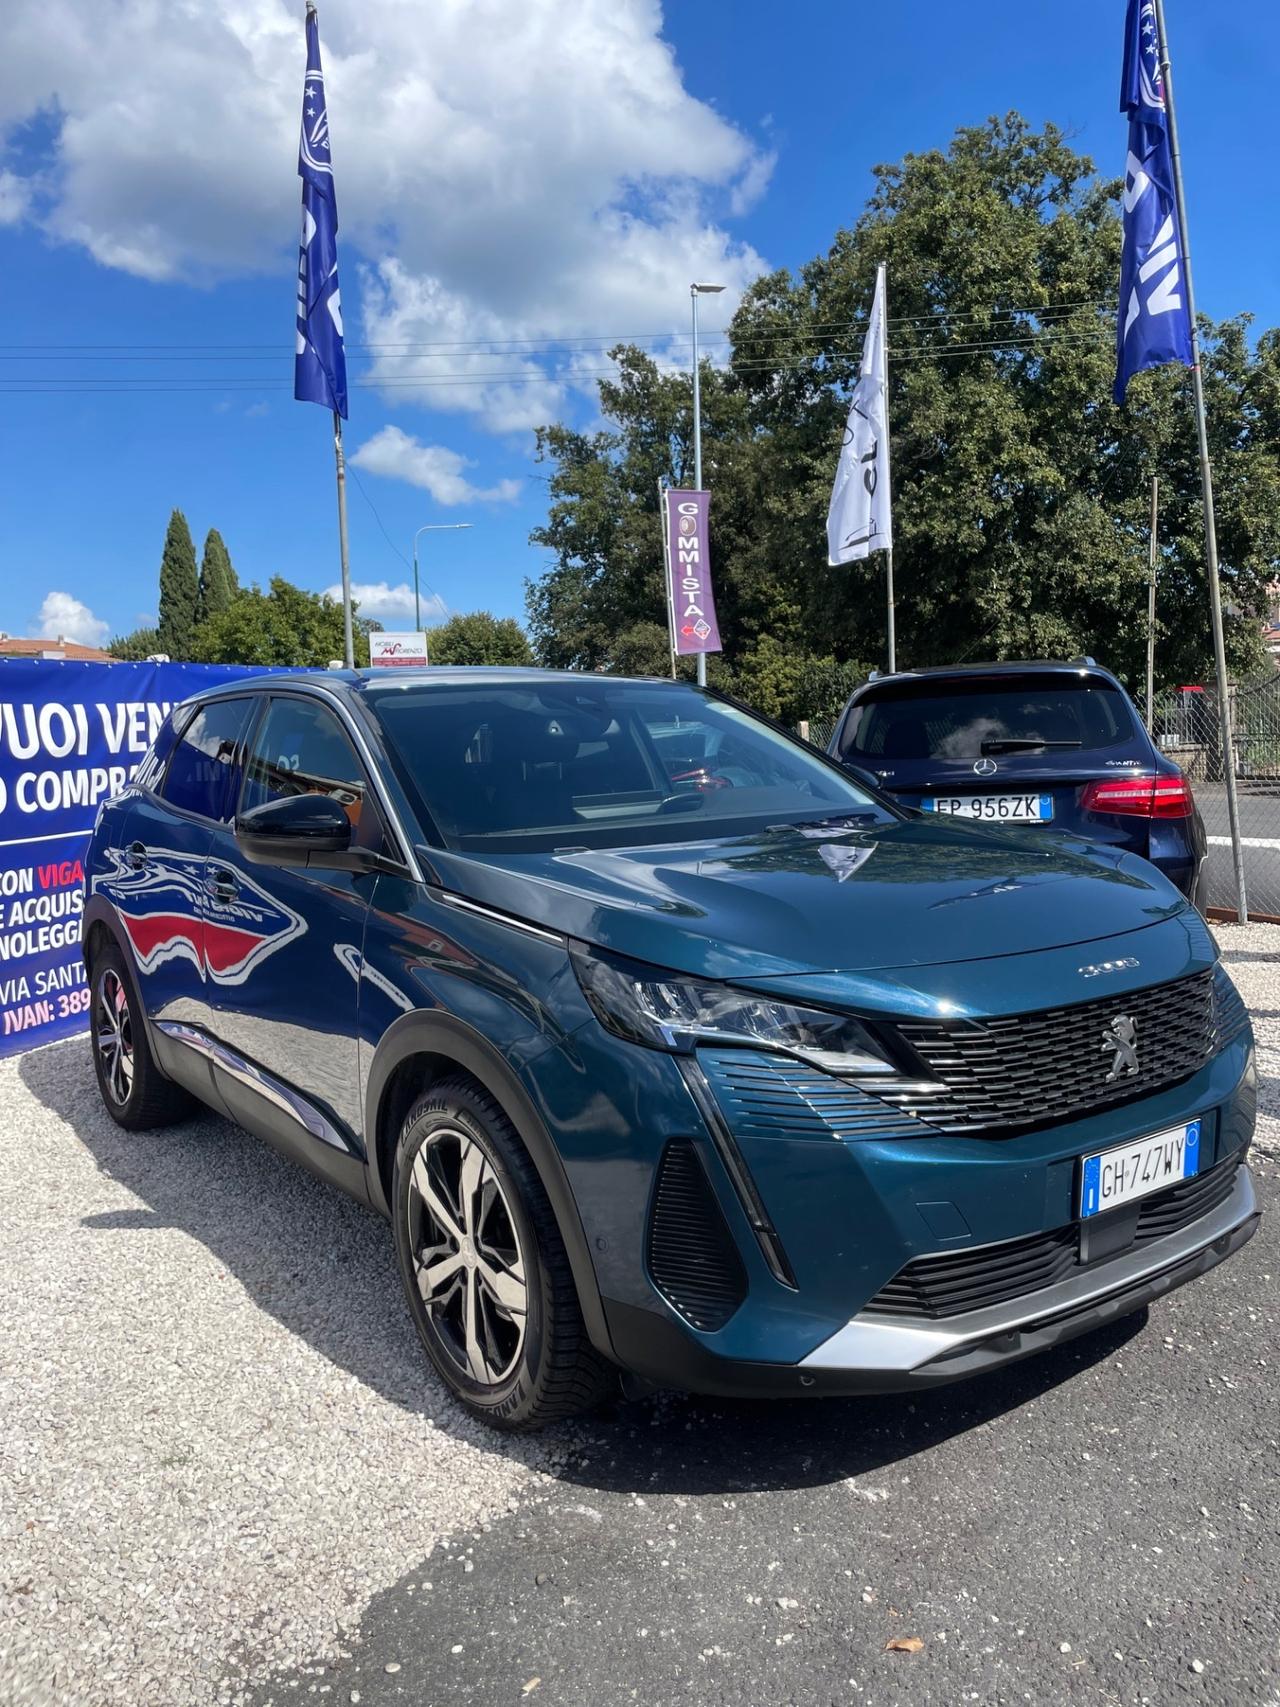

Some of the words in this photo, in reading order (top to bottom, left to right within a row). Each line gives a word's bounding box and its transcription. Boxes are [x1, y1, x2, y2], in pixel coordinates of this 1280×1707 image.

[0, 702, 89, 759] UOI
[95, 702, 175, 754] VEN
[0, 867, 33, 897] ON
[38, 860, 83, 889] VIGA
[8, 889, 83, 927] ACQUIS
[0, 976, 31, 1006] VIA
[3, 999, 56, 1035] IVAN:
[57, 987, 92, 1018] 389
